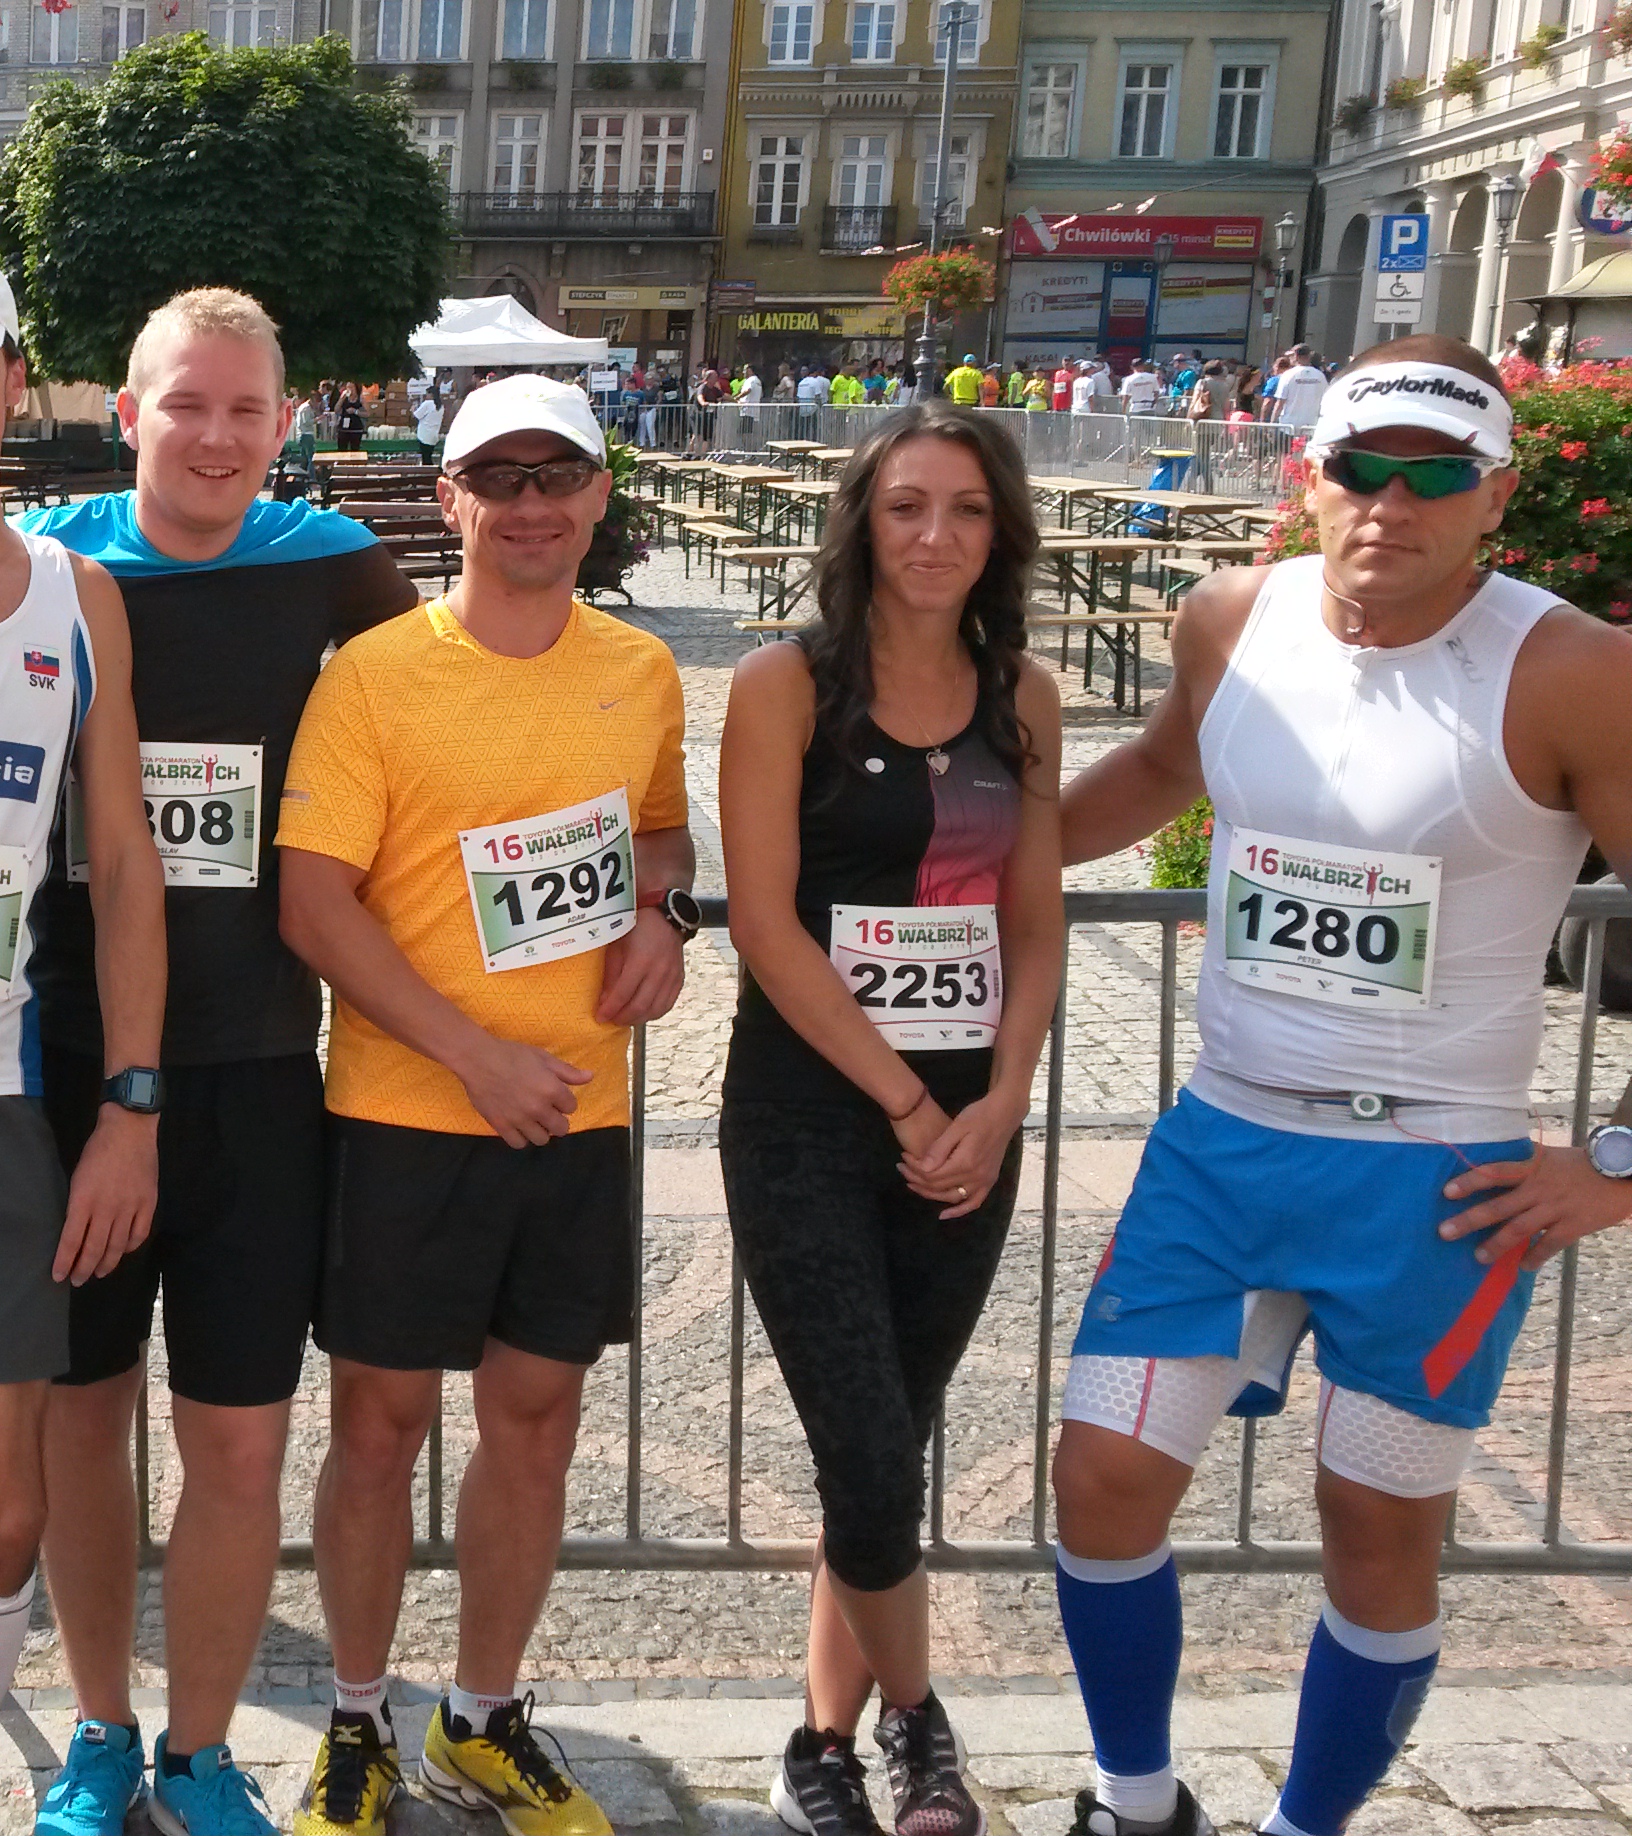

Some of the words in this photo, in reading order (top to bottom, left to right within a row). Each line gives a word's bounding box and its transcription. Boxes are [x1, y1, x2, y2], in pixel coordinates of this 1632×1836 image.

[1402, 134, 1525, 186] BIBLIOTEK
[1064, 227, 1150, 243] Chwilówki
[1390, 219, 1419, 254] P
[738, 311, 820, 331] GALANTERIA
[1348, 374, 1490, 410] TaylorMade
[28, 673, 56, 691] SVK
[141, 759, 240, 784] AŁBRZYCH
[483, 833, 524, 864] 16
[1246, 844, 1280, 875] 16
[493, 851, 626, 927] 1292
[855, 918, 895, 945] 16
[1237, 892, 1400, 965] 1280
[850, 961, 988, 1009] 2253
